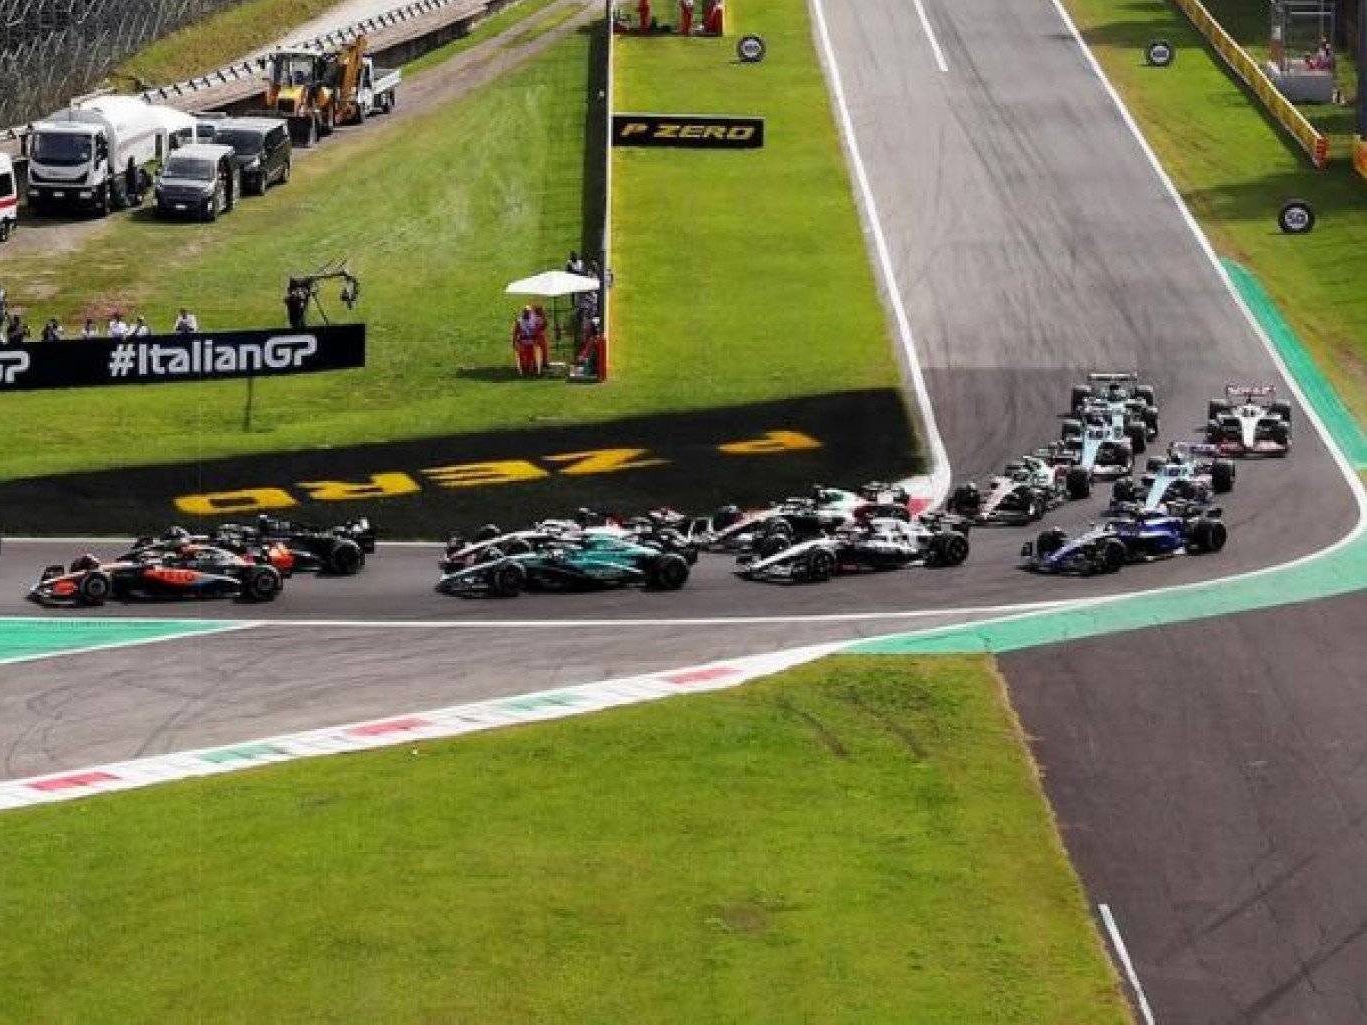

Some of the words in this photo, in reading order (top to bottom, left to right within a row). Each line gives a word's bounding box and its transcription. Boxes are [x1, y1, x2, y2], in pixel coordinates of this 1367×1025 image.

[619, 122, 648, 138] P
[653, 123, 756, 140] ZERO
[107, 333, 319, 378] #ItalianGP
